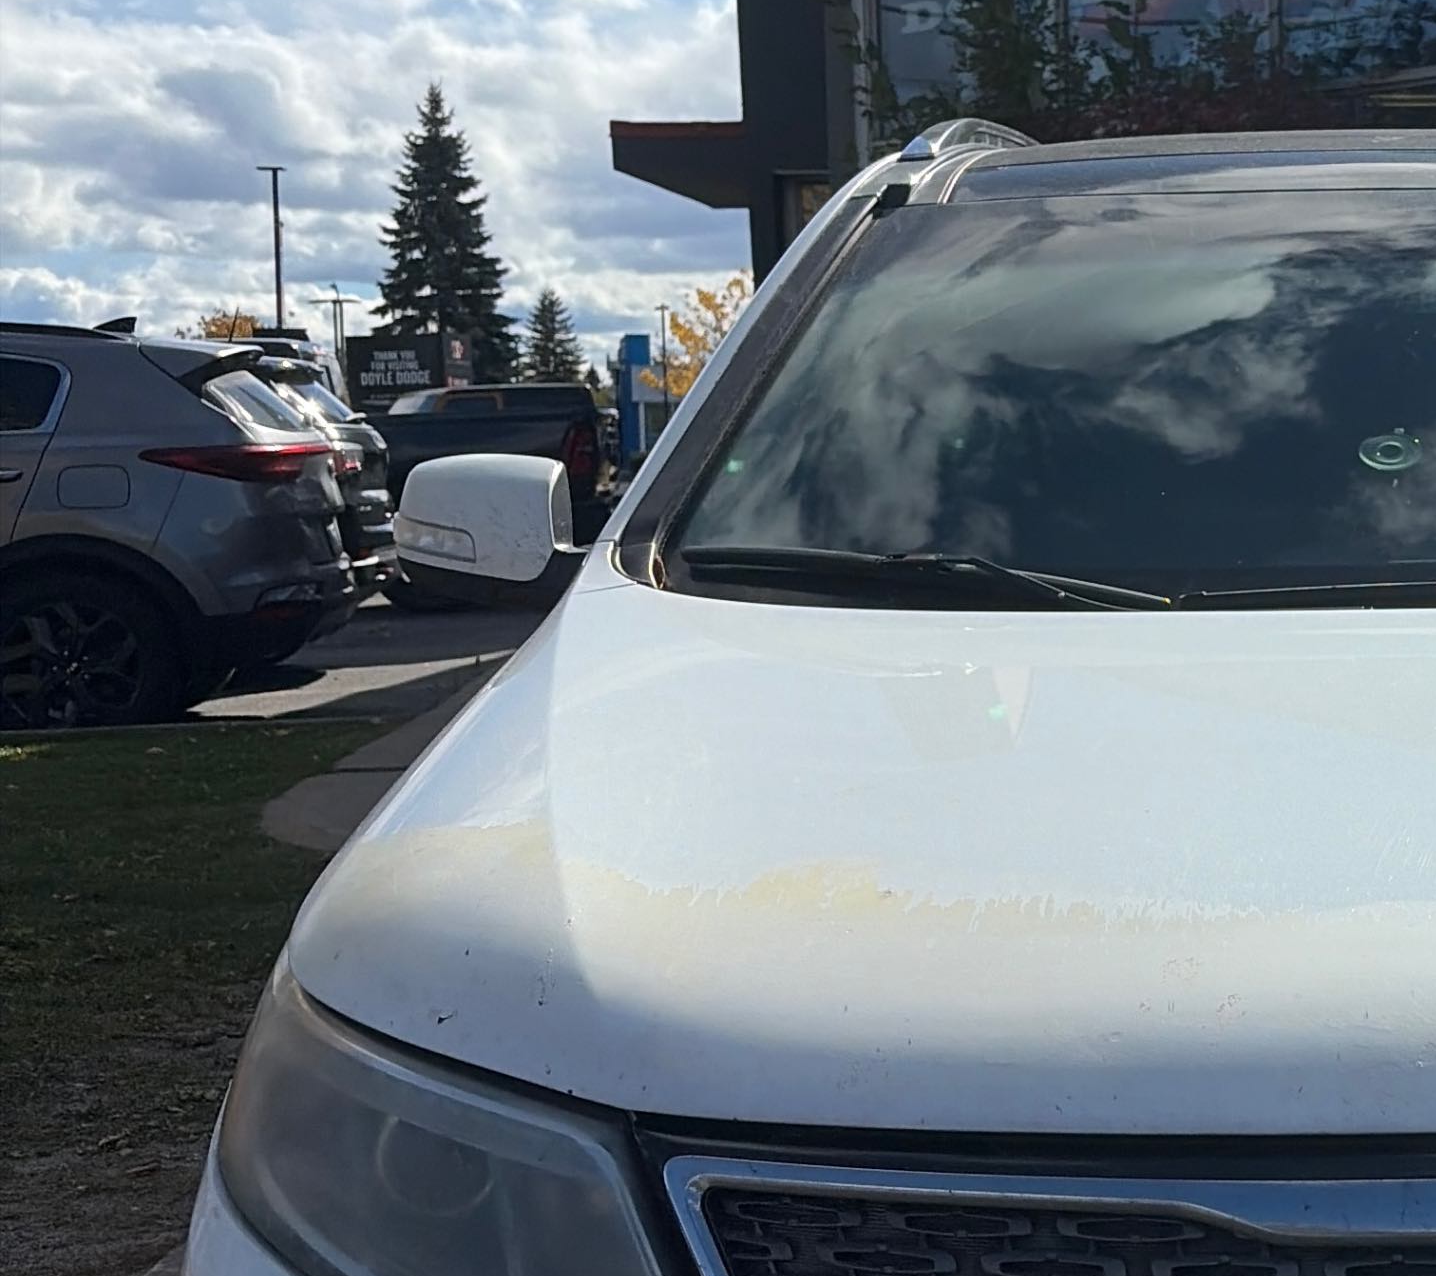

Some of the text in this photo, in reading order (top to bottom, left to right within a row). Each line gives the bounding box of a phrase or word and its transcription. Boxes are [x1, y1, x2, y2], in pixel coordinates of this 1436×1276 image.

[373, 350, 416, 360] THANK YOU
[371, 360, 419, 370] FOR VISITING
[361, 371, 393, 386] DOYLE
[396, 370, 431, 384] DODGE
